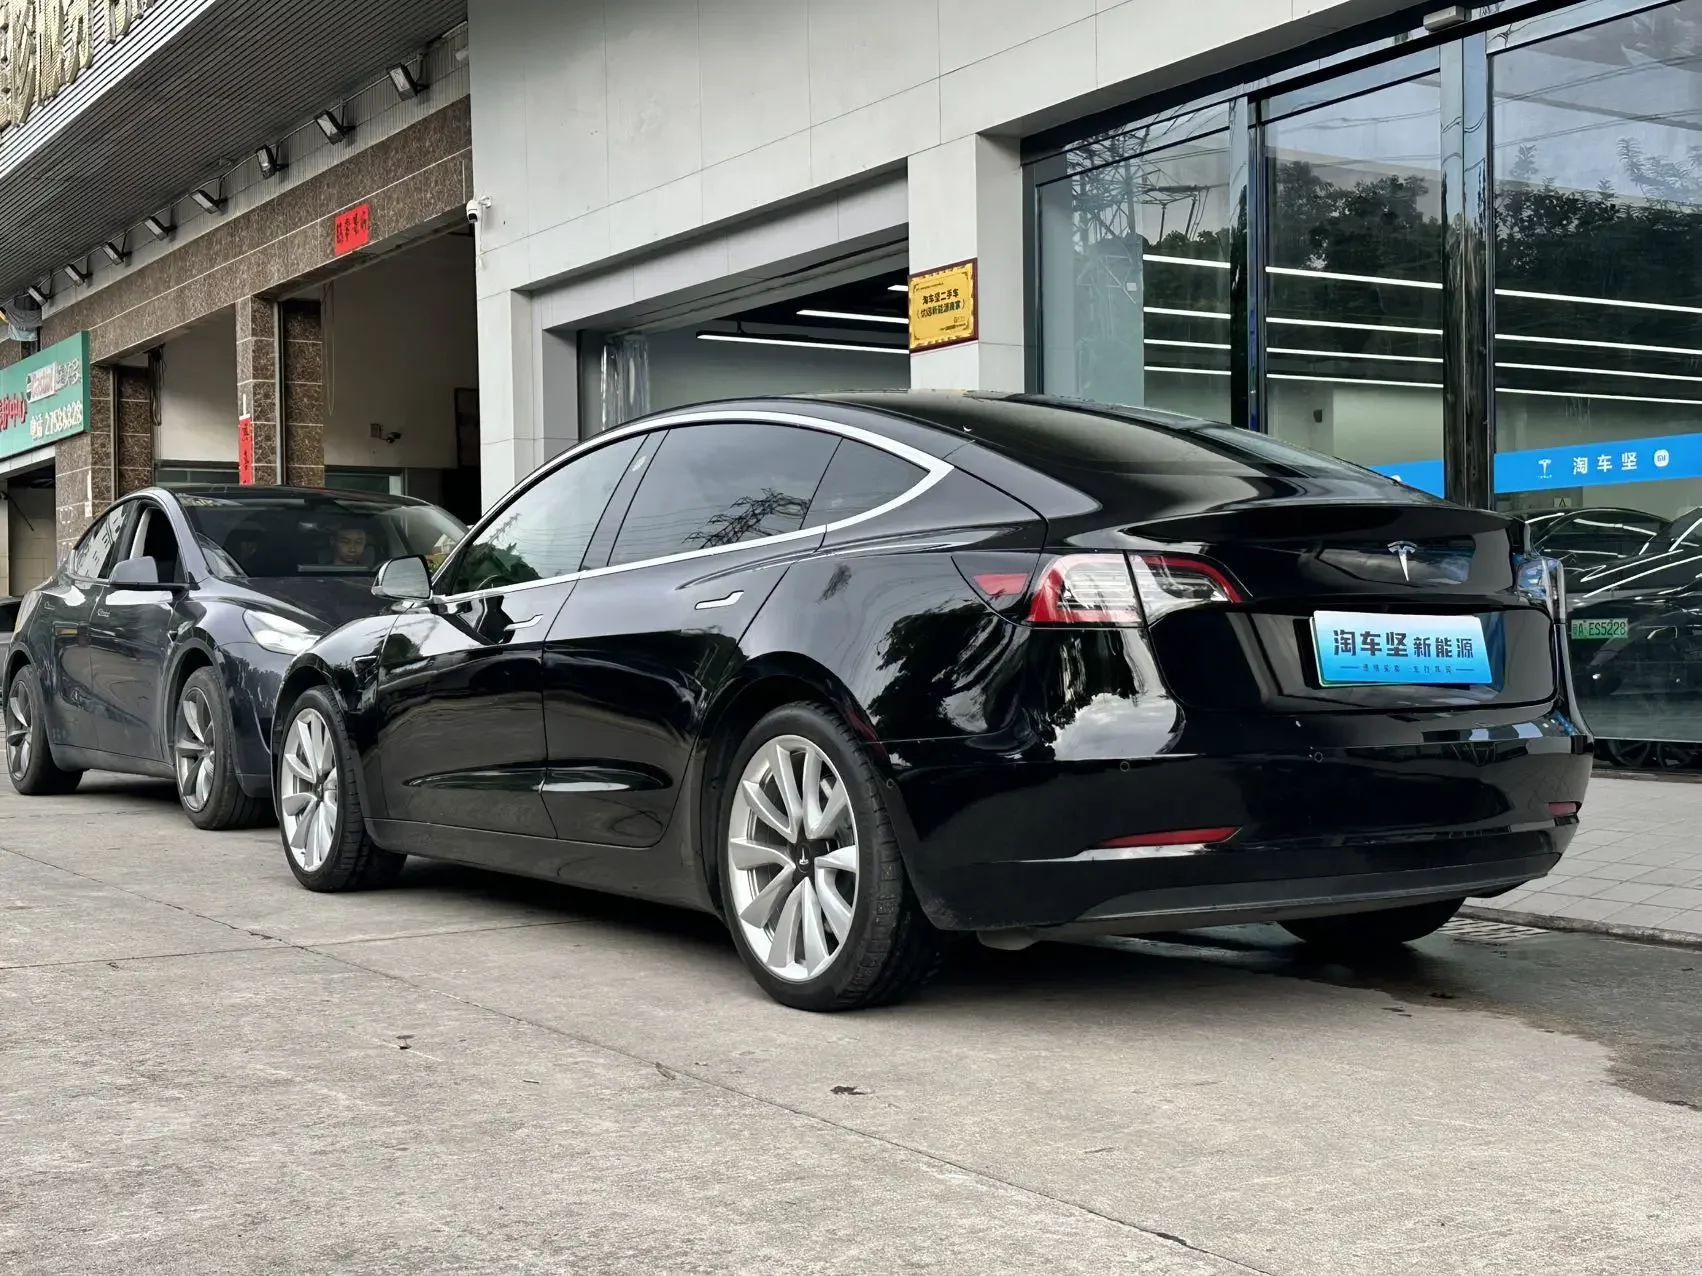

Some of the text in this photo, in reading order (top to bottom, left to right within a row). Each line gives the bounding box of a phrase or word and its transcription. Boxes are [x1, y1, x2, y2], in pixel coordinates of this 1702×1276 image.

[1572, 451, 1638, 475] 淘车坚
[1588, 621, 1626, 636] ES5228
